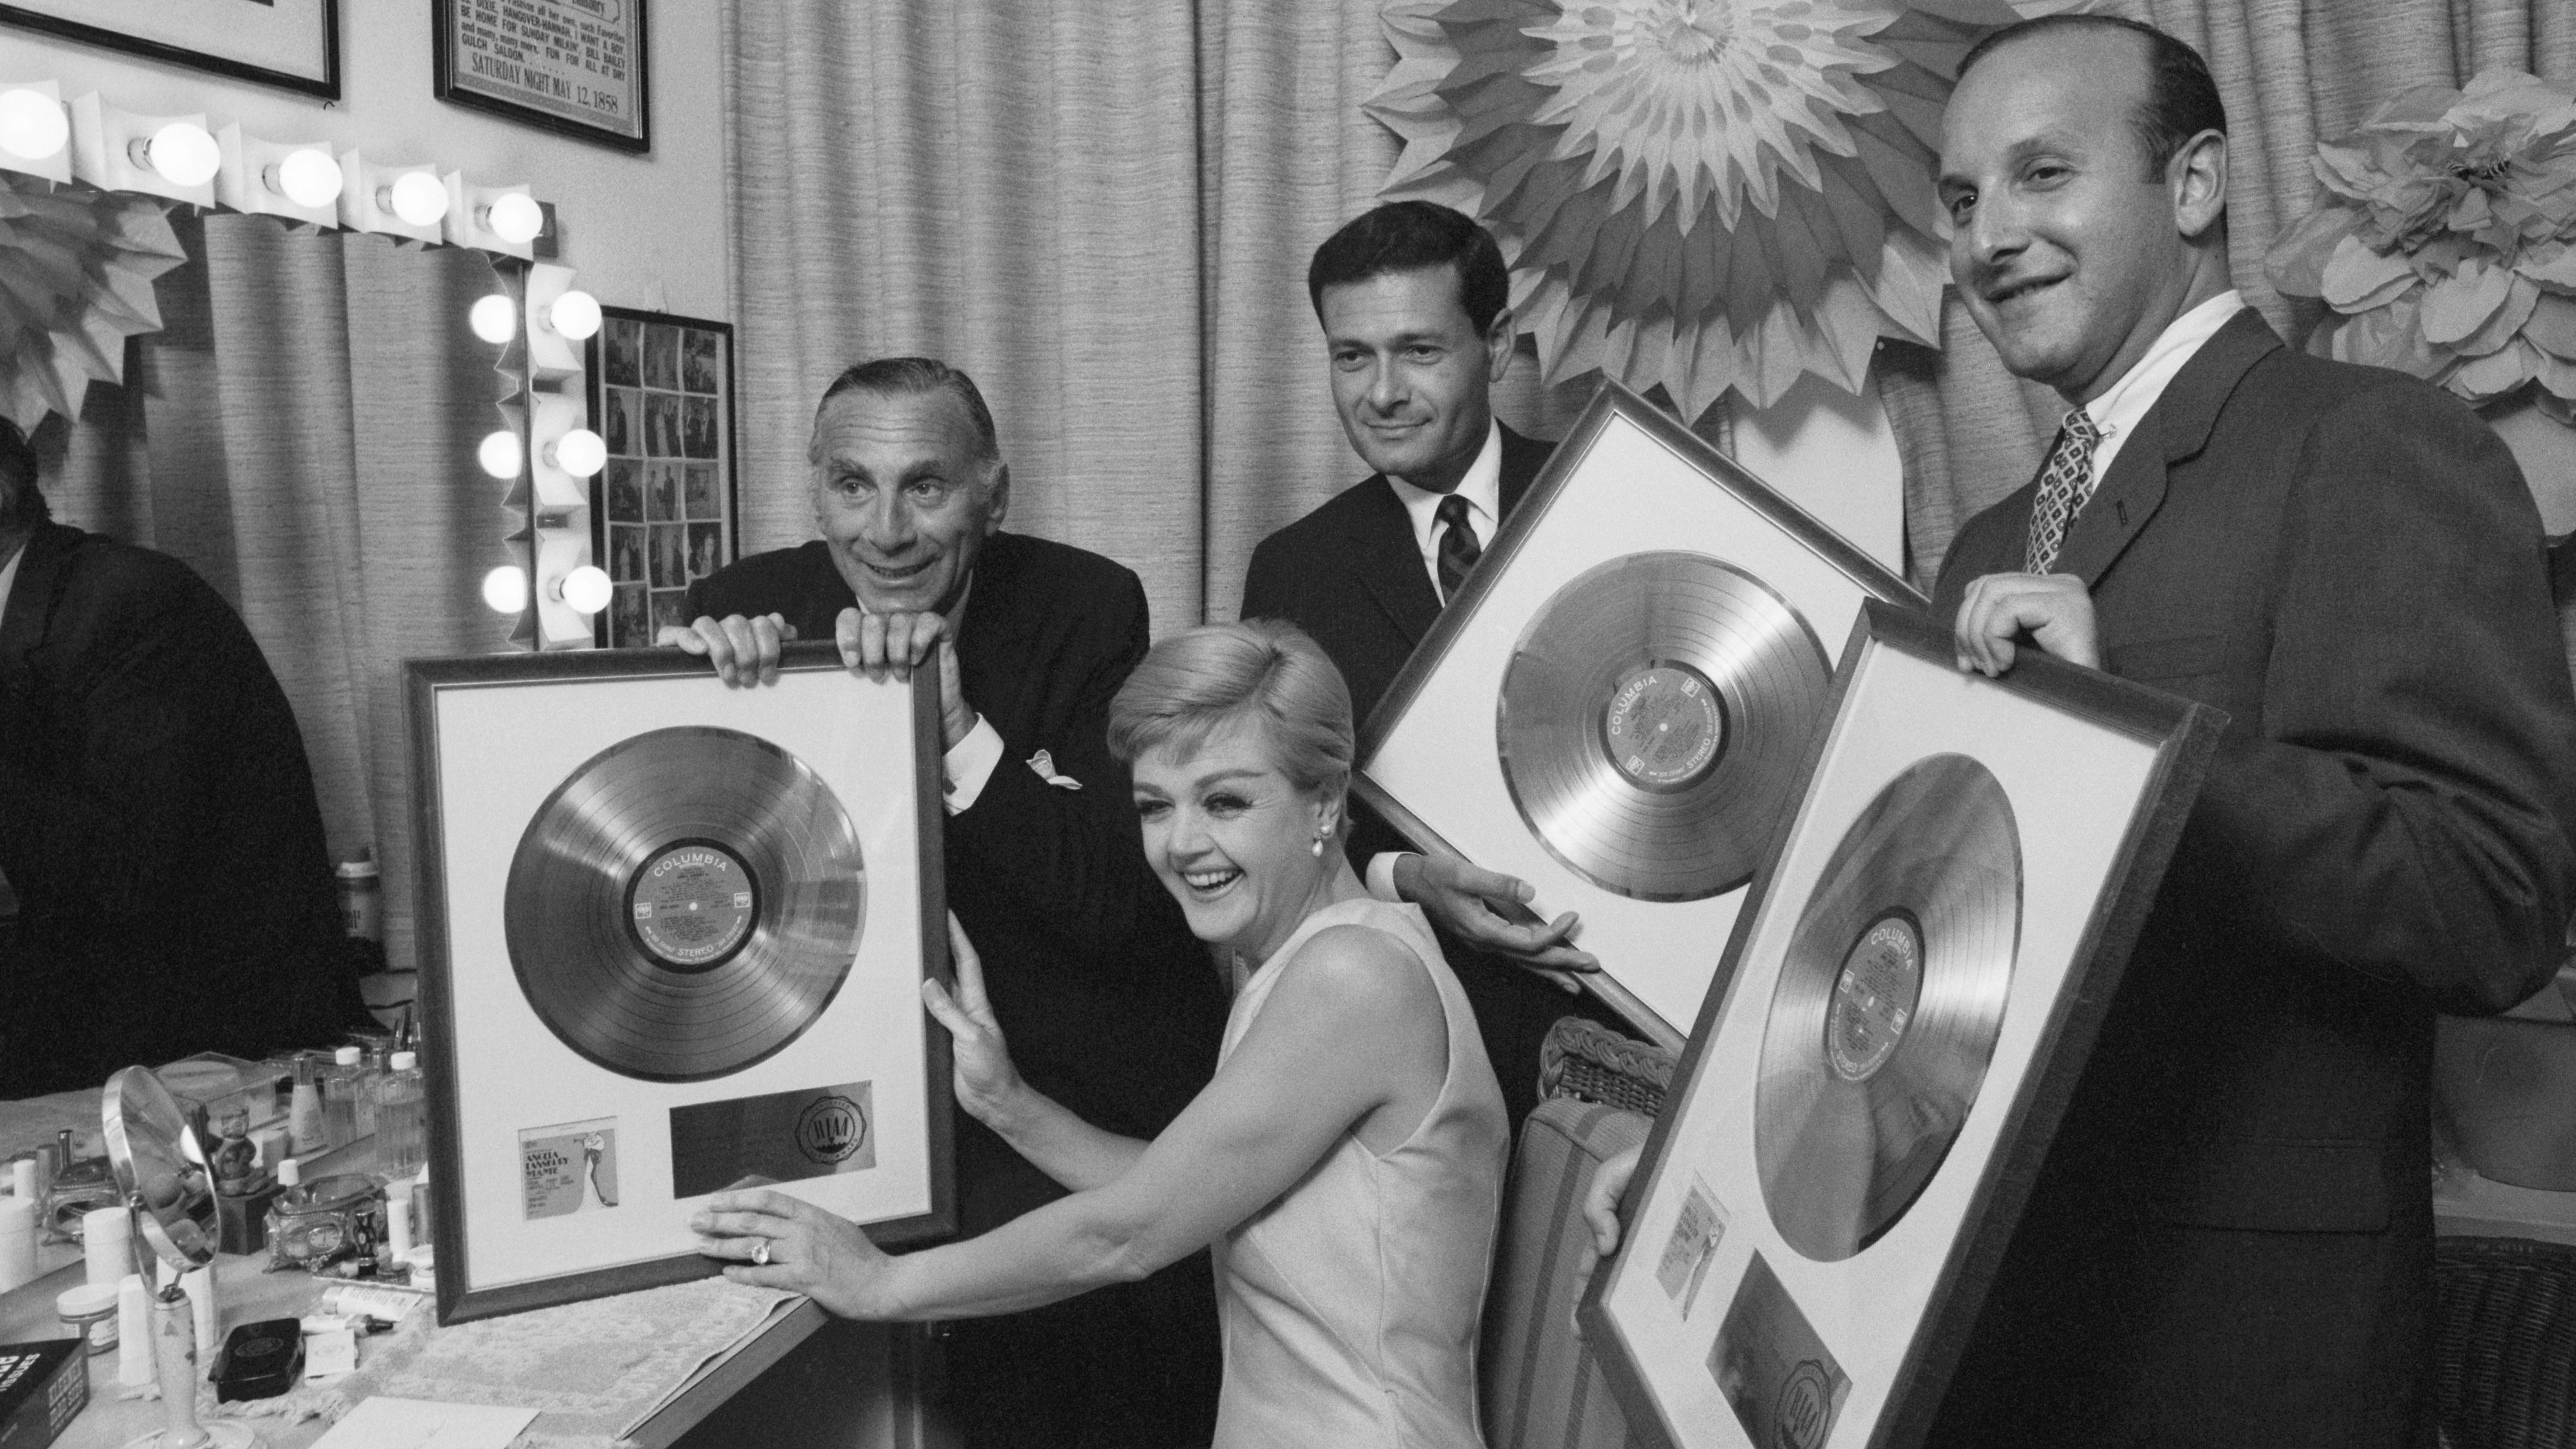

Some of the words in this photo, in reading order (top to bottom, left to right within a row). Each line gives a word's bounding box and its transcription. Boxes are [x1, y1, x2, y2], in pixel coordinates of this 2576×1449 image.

[461, 5, 471, 18] BE
[476, 10, 498, 27] HOME
[502, 19, 517, 33] FOR
[521, 25, 550, 43] SUNDAY
[586, 47, 600, 61] BILL
[603, 53, 625, 69] BAILEY
[462, 32, 488, 51] GULCH
[549, 8, 559, 20] her
[597, 25, 625, 43] Favorites
[581, 32, 599, 48] WANT
[603, 40, 608, 51] A
[461, 22, 475, 33] and
[477, 27, 498, 43] many,
[500, 35, 519, 49] many
[546, 47, 559, 60] FUN
[566, 53, 579, 67] FOR
[585, 60, 597, 73] ALL
[602, 65, 609, 76] AT
[613, 69, 625, 82] DRY
[472, 52, 520, 84] SATURDAY
[524, 69, 550, 93] NIGHT
[553, 77, 571, 99] MAY
[577, 86, 591, 108] 12,
[593, 91, 618, 114] 1858
[1612, 675, 1657, 735] COLUMBIA
[1686, 737, 1712, 769] STEREO
[653, 852, 727, 877] COLUMBIA
[677, 944, 714, 957] STEREO
[1870, 927, 1914, 970] COLUMBIA
[526, 1151, 559, 1161] ANGELA
